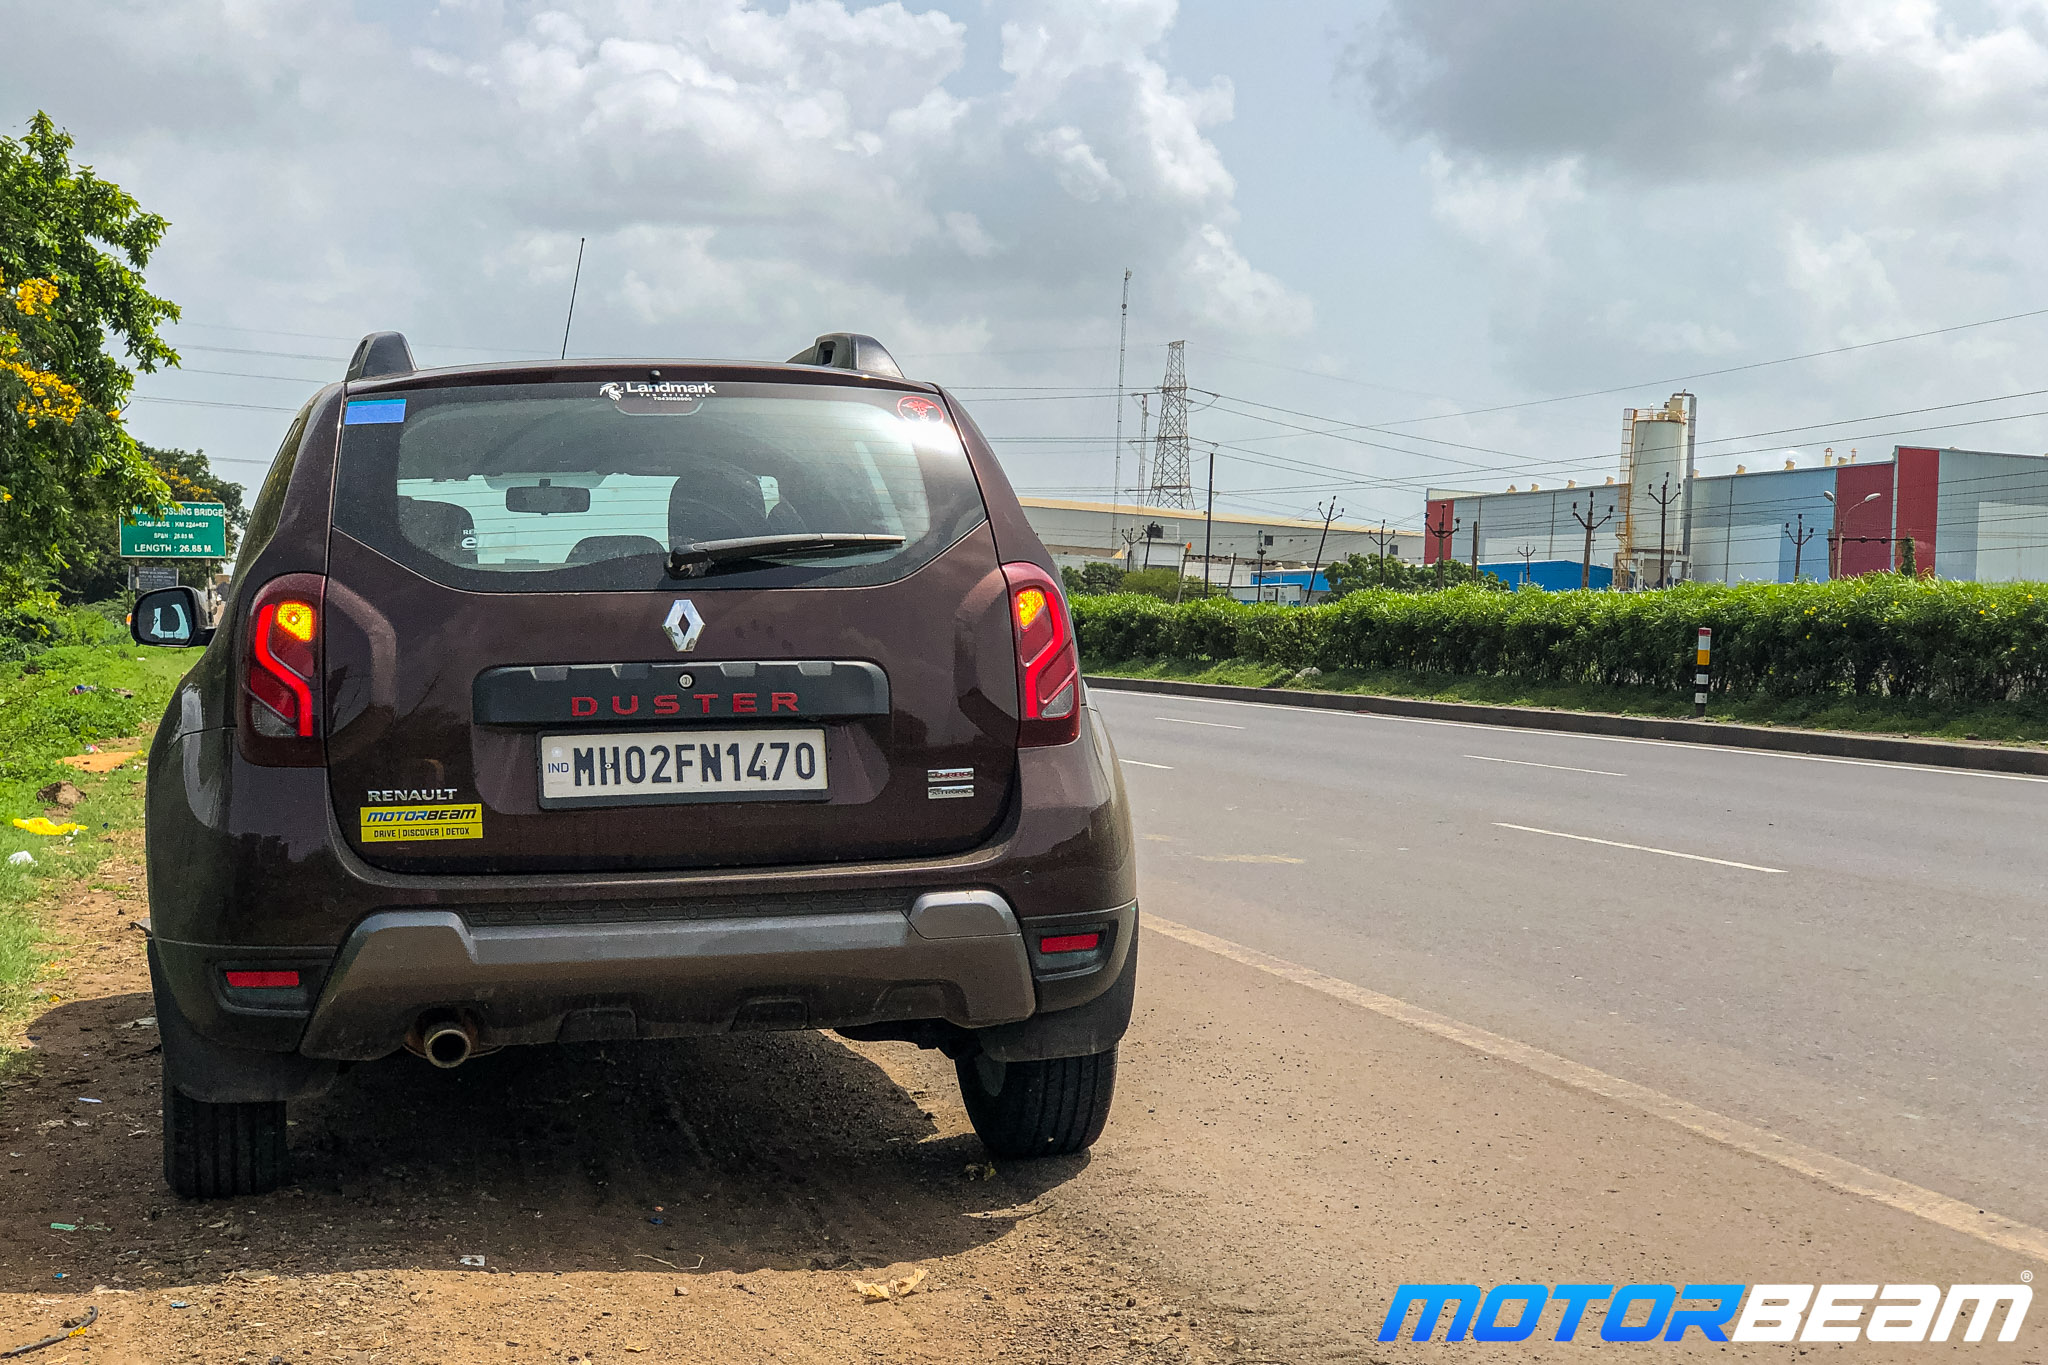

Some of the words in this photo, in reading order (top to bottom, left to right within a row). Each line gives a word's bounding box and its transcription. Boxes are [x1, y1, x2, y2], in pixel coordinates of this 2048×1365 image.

[626, 382, 716, 394] Landmark
[194, 507, 224, 517] BRIDGE
[134, 543, 172, 552] LENGTH
[571, 692, 800, 717] DUSTER
[548, 762, 569, 774] IND
[573, 742, 817, 787] MH02FN1470
[367, 788, 458, 802] RENAULT
[366, 808, 477, 823] MOTORBEAM
[373, 829, 396, 838] DRIVE
[402, 828, 439, 837] DISCOVER
[446, 827, 470, 836] DETOX
